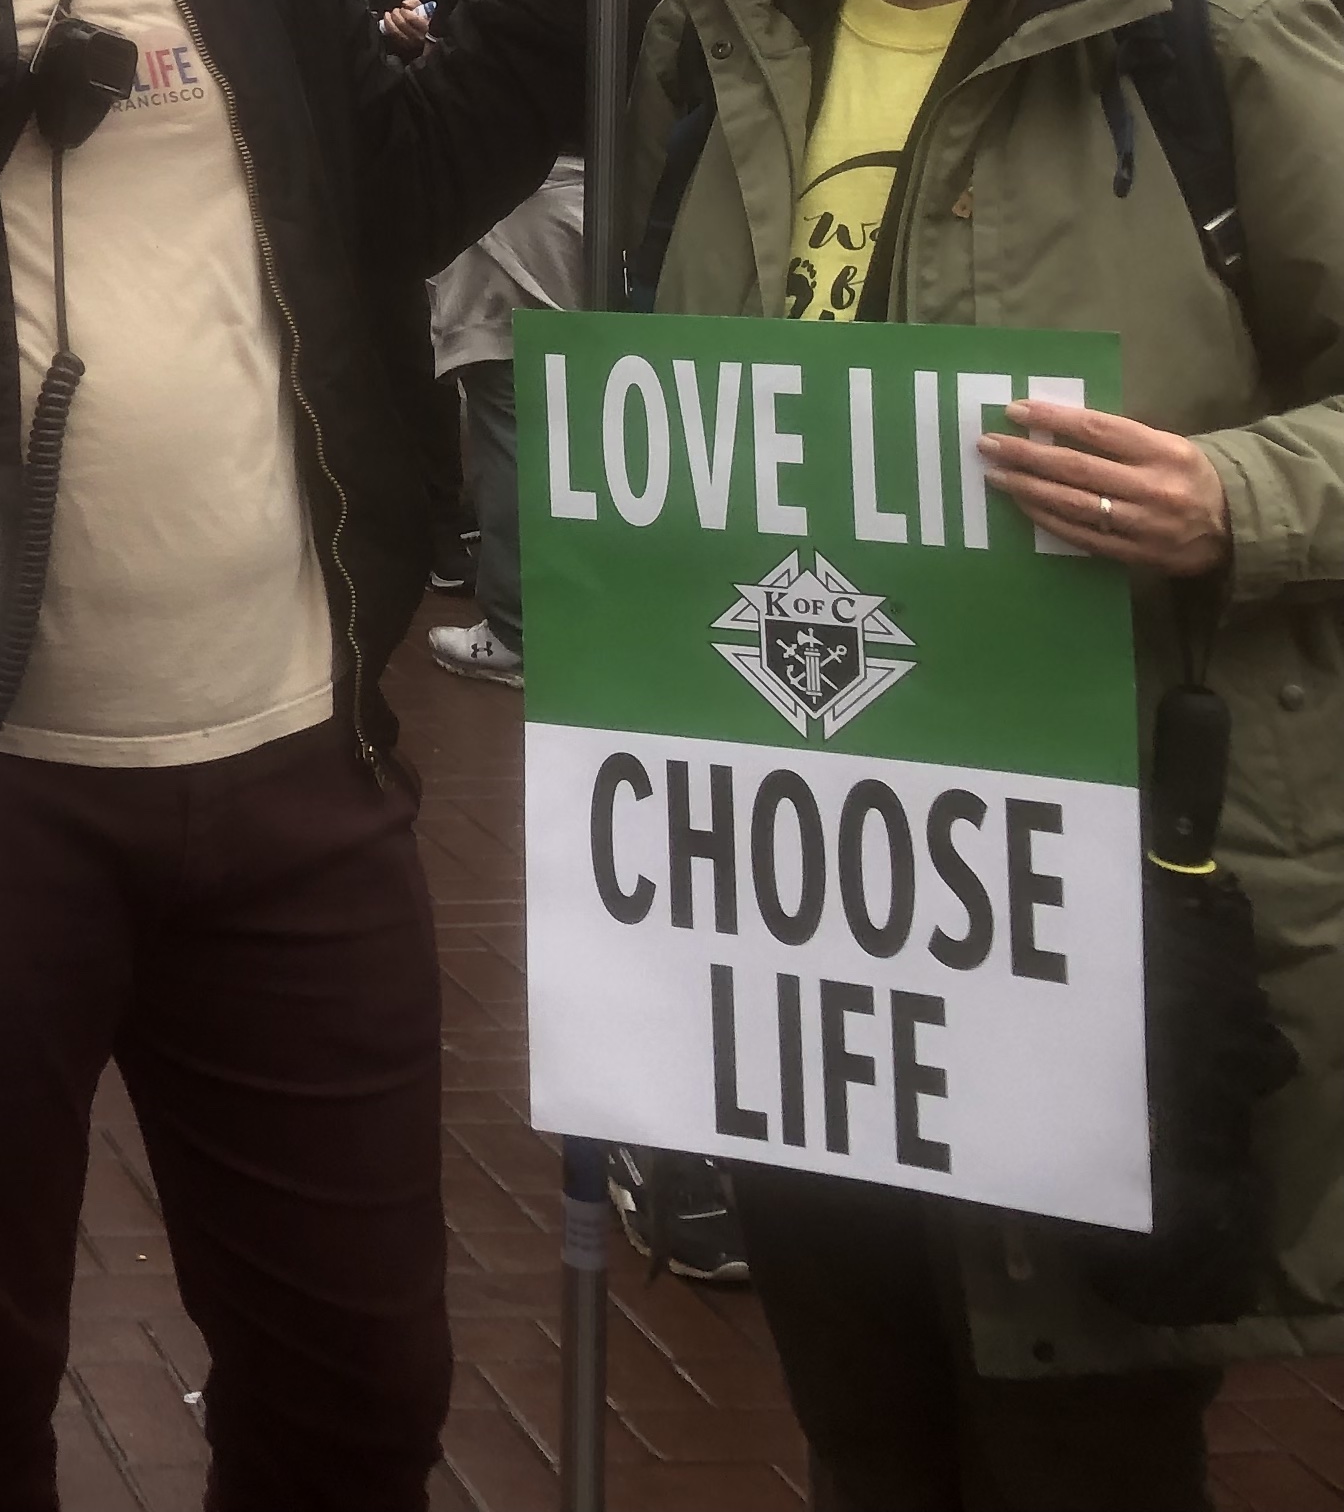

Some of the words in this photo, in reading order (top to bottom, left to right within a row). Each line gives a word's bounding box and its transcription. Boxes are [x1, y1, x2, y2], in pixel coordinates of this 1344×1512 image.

[112, 87, 205, 112] RANCISCO
[544, 352, 809, 536] LOVE
[764, 591, 791, 618] K
[831, 596, 857, 623] C
[590, 751, 1069, 984] CHOOSE
[711, 963, 952, 1174] LIFE
